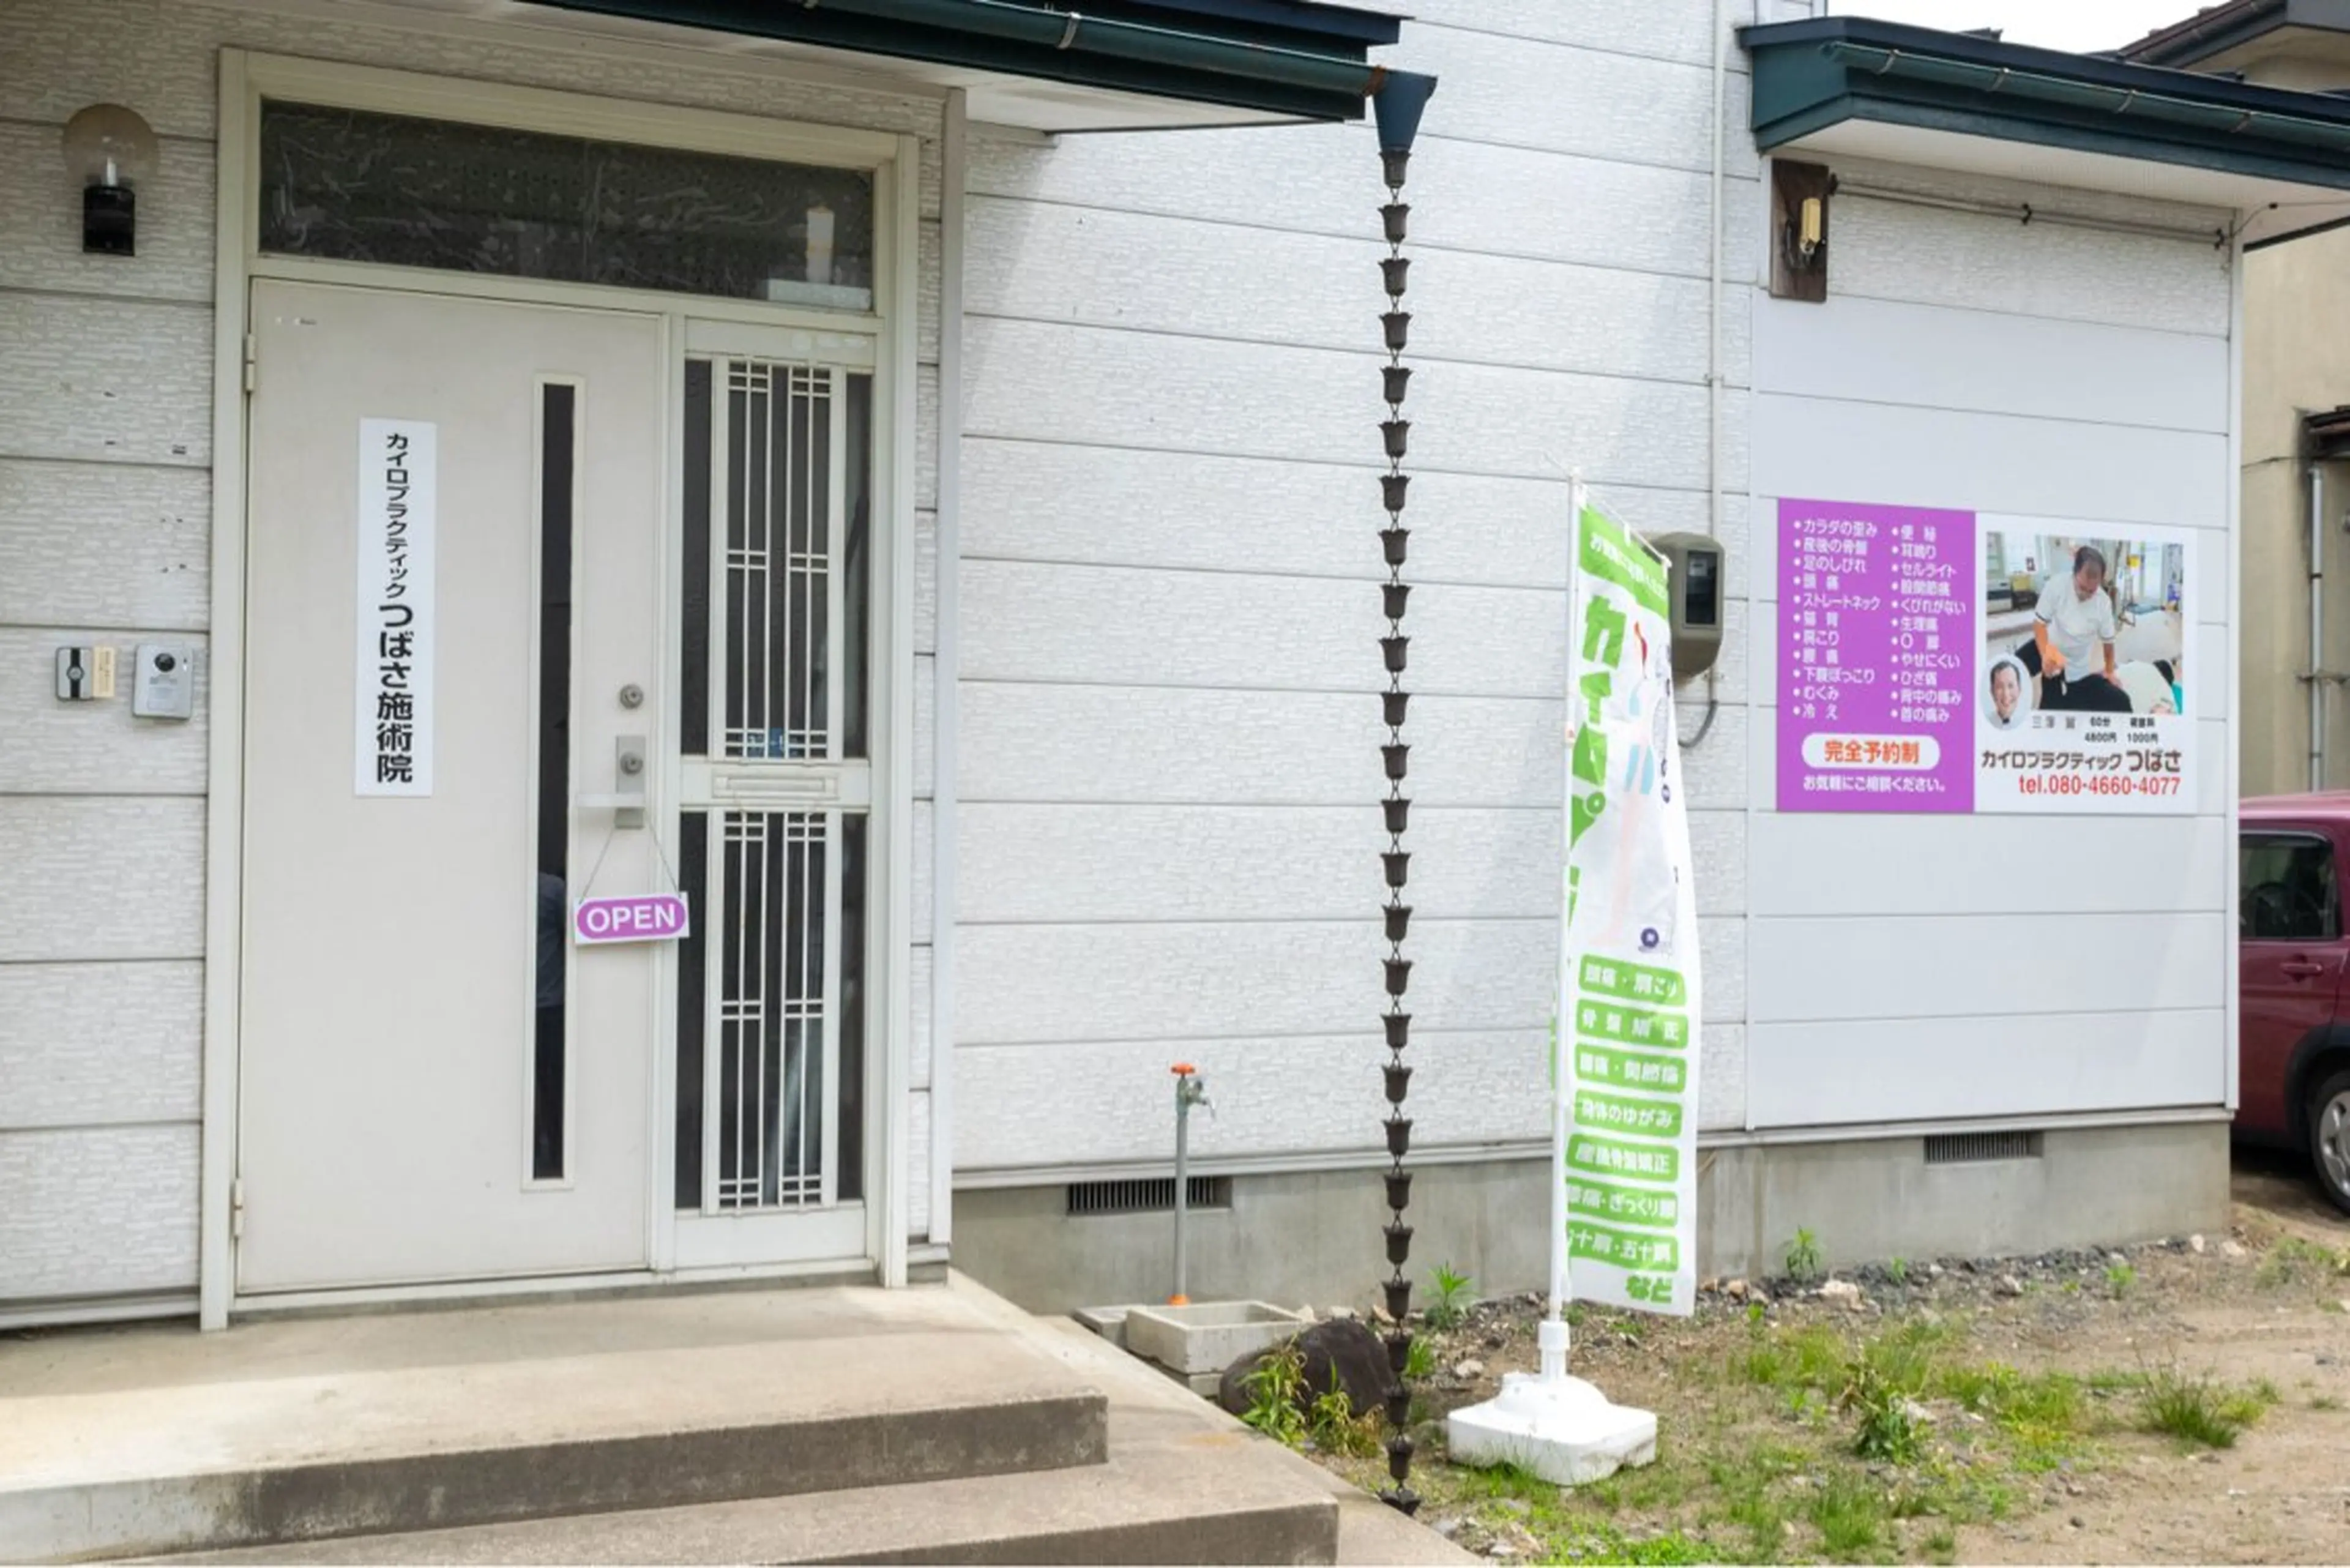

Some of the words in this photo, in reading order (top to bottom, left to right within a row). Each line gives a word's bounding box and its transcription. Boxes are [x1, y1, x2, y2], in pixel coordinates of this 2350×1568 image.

[1804, 592, 1881, 611] ストレートネック
[1824, 739, 1920, 764] 完全予約制
[2126, 749, 2182, 773] つばさ
[586, 903, 676, 933] OPEN
[1625, 1274, 1673, 1304] など
